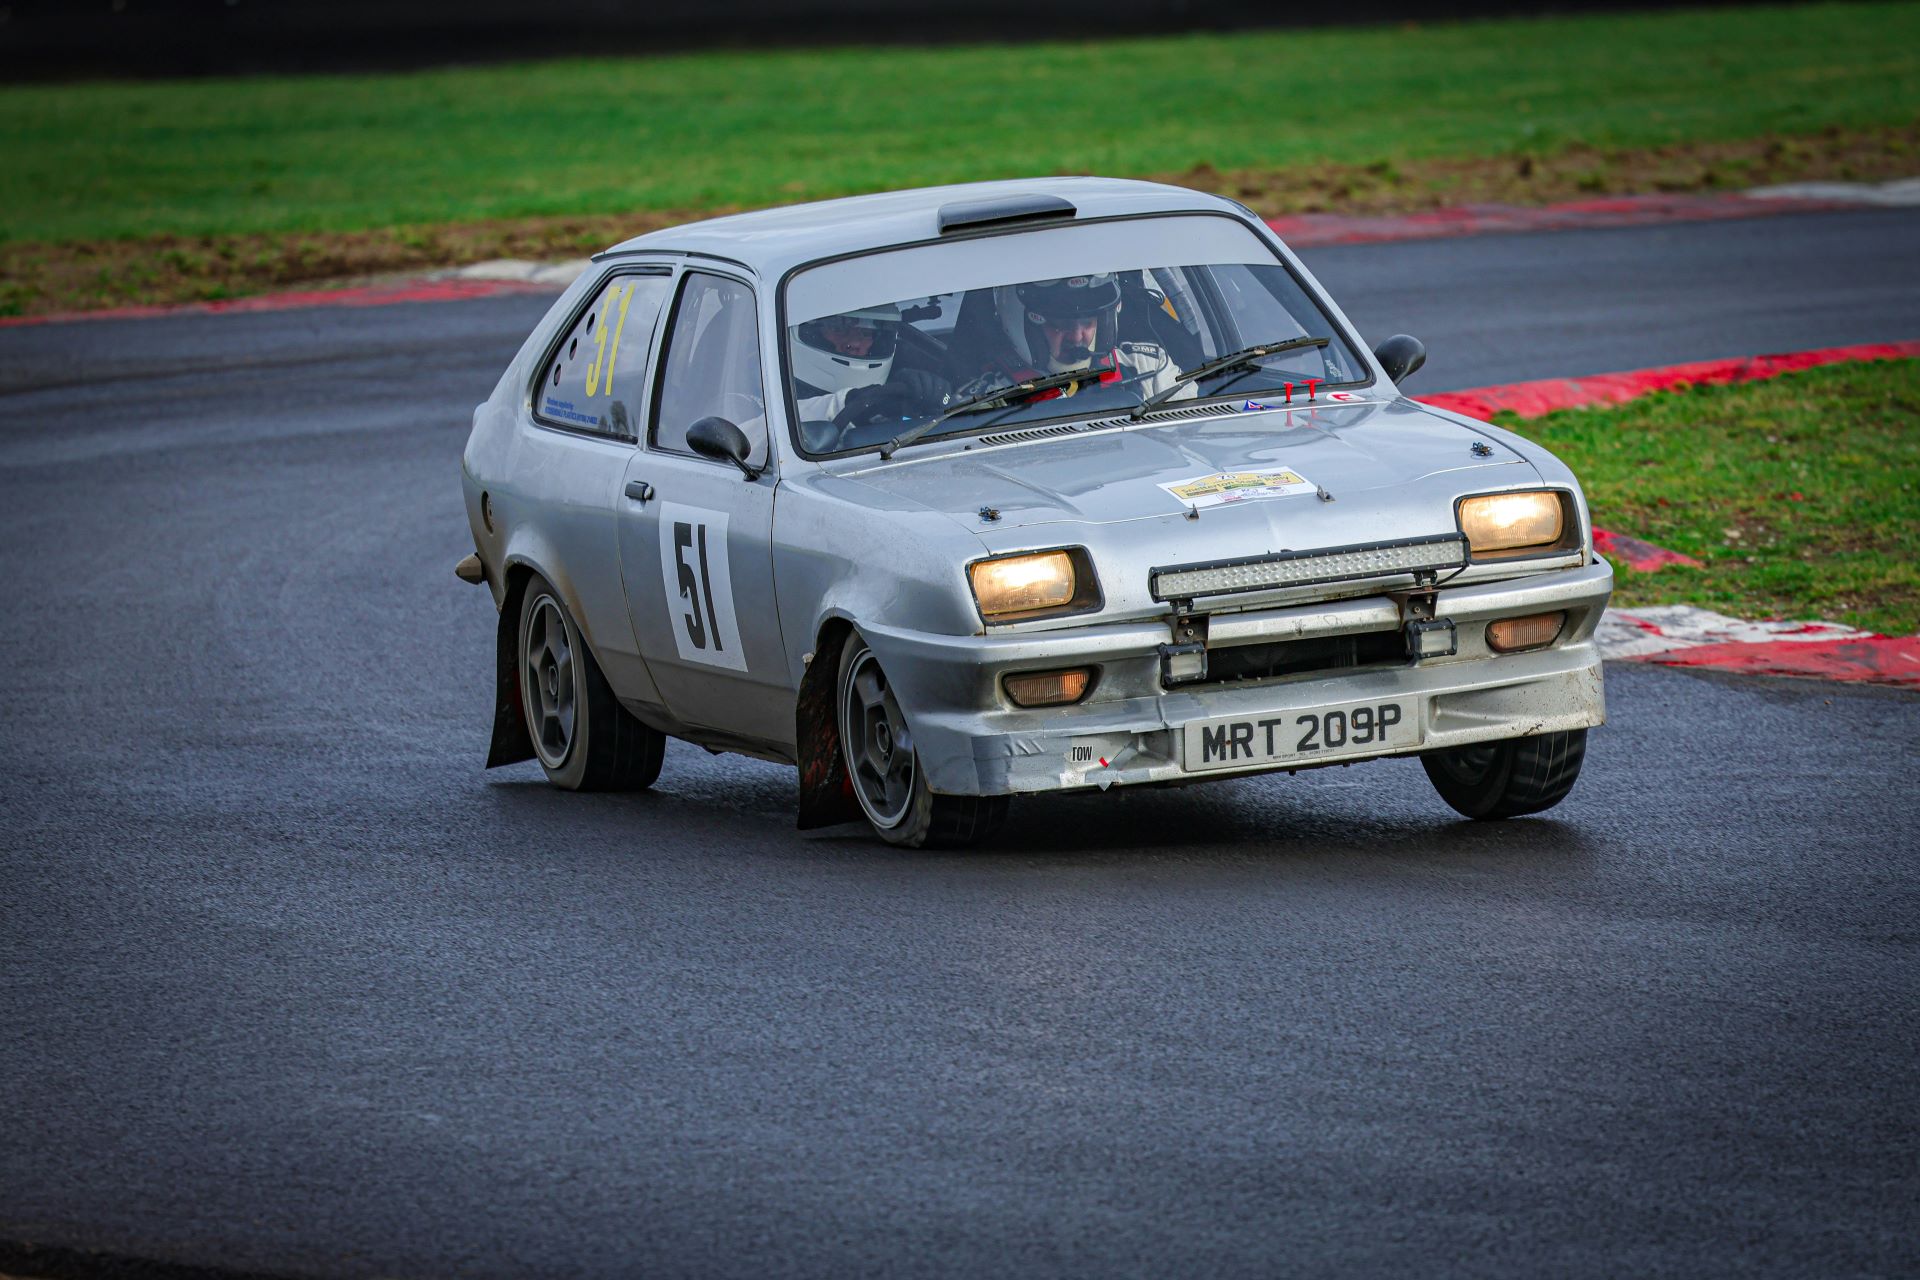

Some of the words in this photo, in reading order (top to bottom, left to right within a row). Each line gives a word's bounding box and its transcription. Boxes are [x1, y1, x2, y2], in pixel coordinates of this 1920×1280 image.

[586, 282, 635, 397] 51
[674, 522, 723, 651] 51
[1072, 746, 1092, 761] TOW
[1202, 718, 1281, 763] MRT
[1296, 703, 1401, 752] 209P
